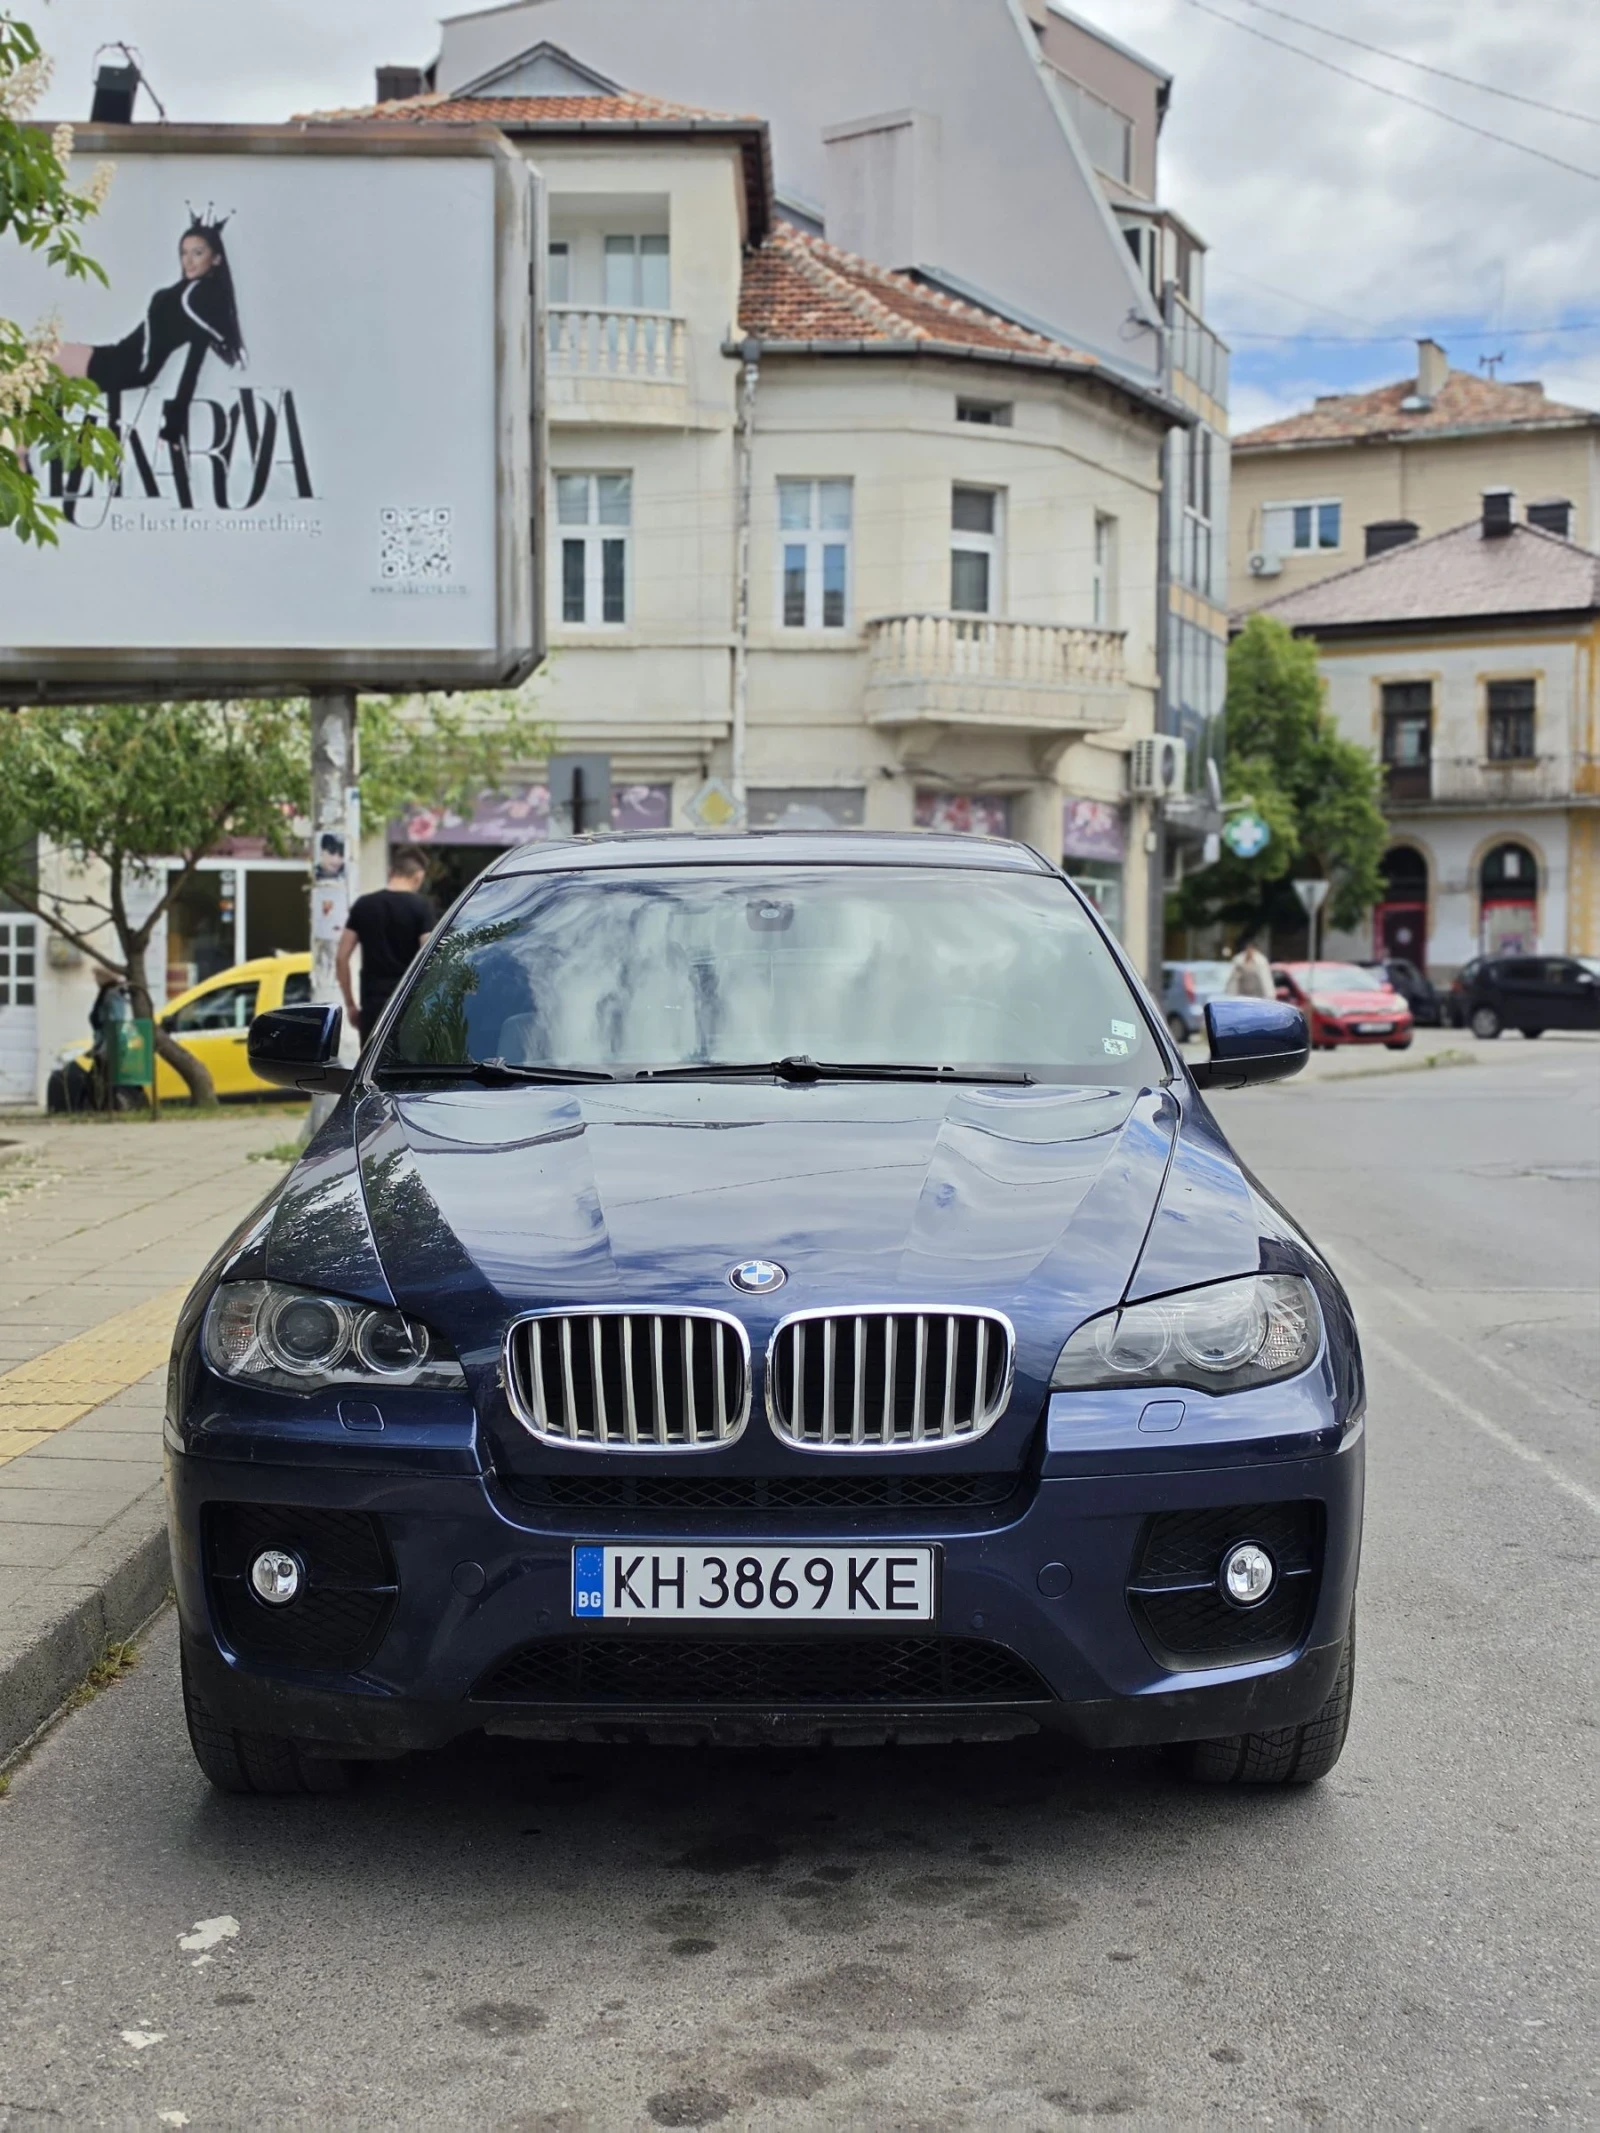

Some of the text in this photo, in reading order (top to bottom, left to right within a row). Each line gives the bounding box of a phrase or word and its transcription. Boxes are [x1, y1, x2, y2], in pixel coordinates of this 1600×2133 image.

[111, 512, 322, 538] Be lust for something
[613, 1556, 919, 1611] KH 3869 KE
[577, 1591, 602, 1608] BG
